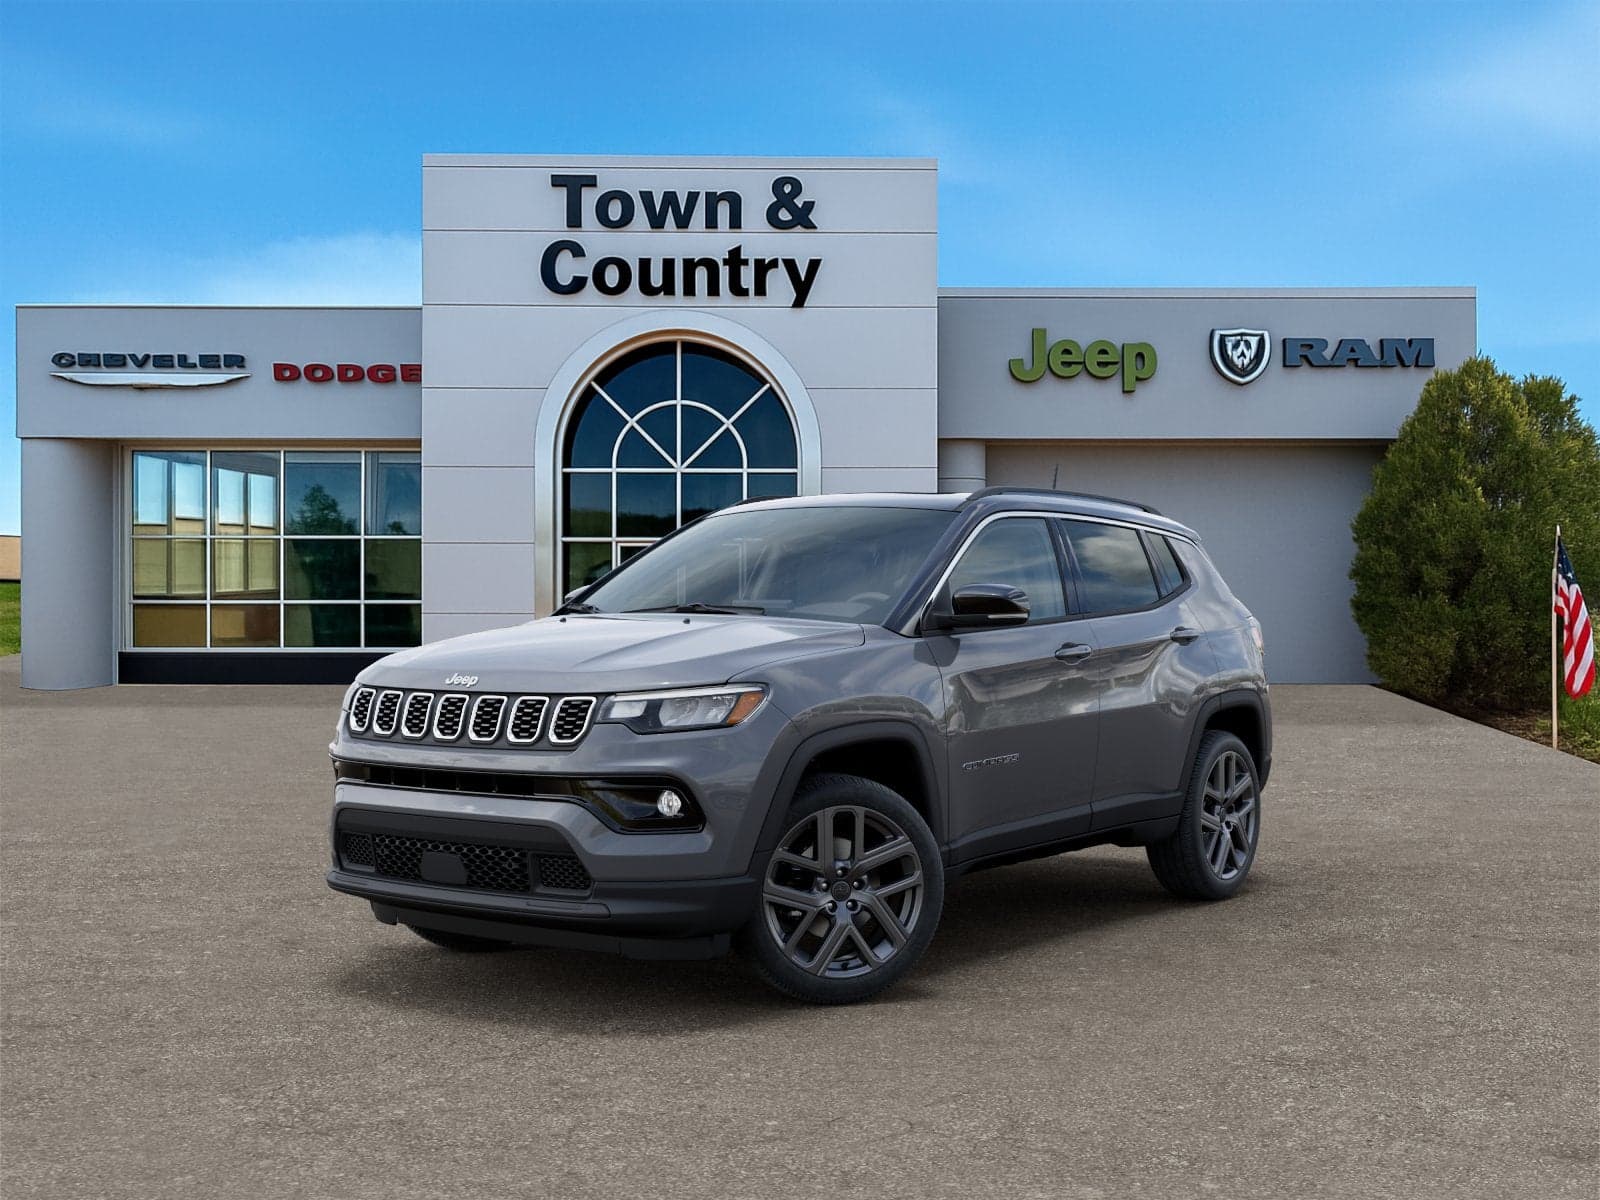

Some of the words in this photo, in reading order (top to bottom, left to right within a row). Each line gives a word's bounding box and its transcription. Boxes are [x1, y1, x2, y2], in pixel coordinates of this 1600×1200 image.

[551, 174, 742, 229] Town
[766, 176, 818, 230] &
[540, 239, 822, 308] Country
[273, 362, 422, 383] DODGE
[1009, 328, 1157, 393] Jeep
[1282, 337, 1435, 368] RAM
[445, 672, 479, 688] Jeep
